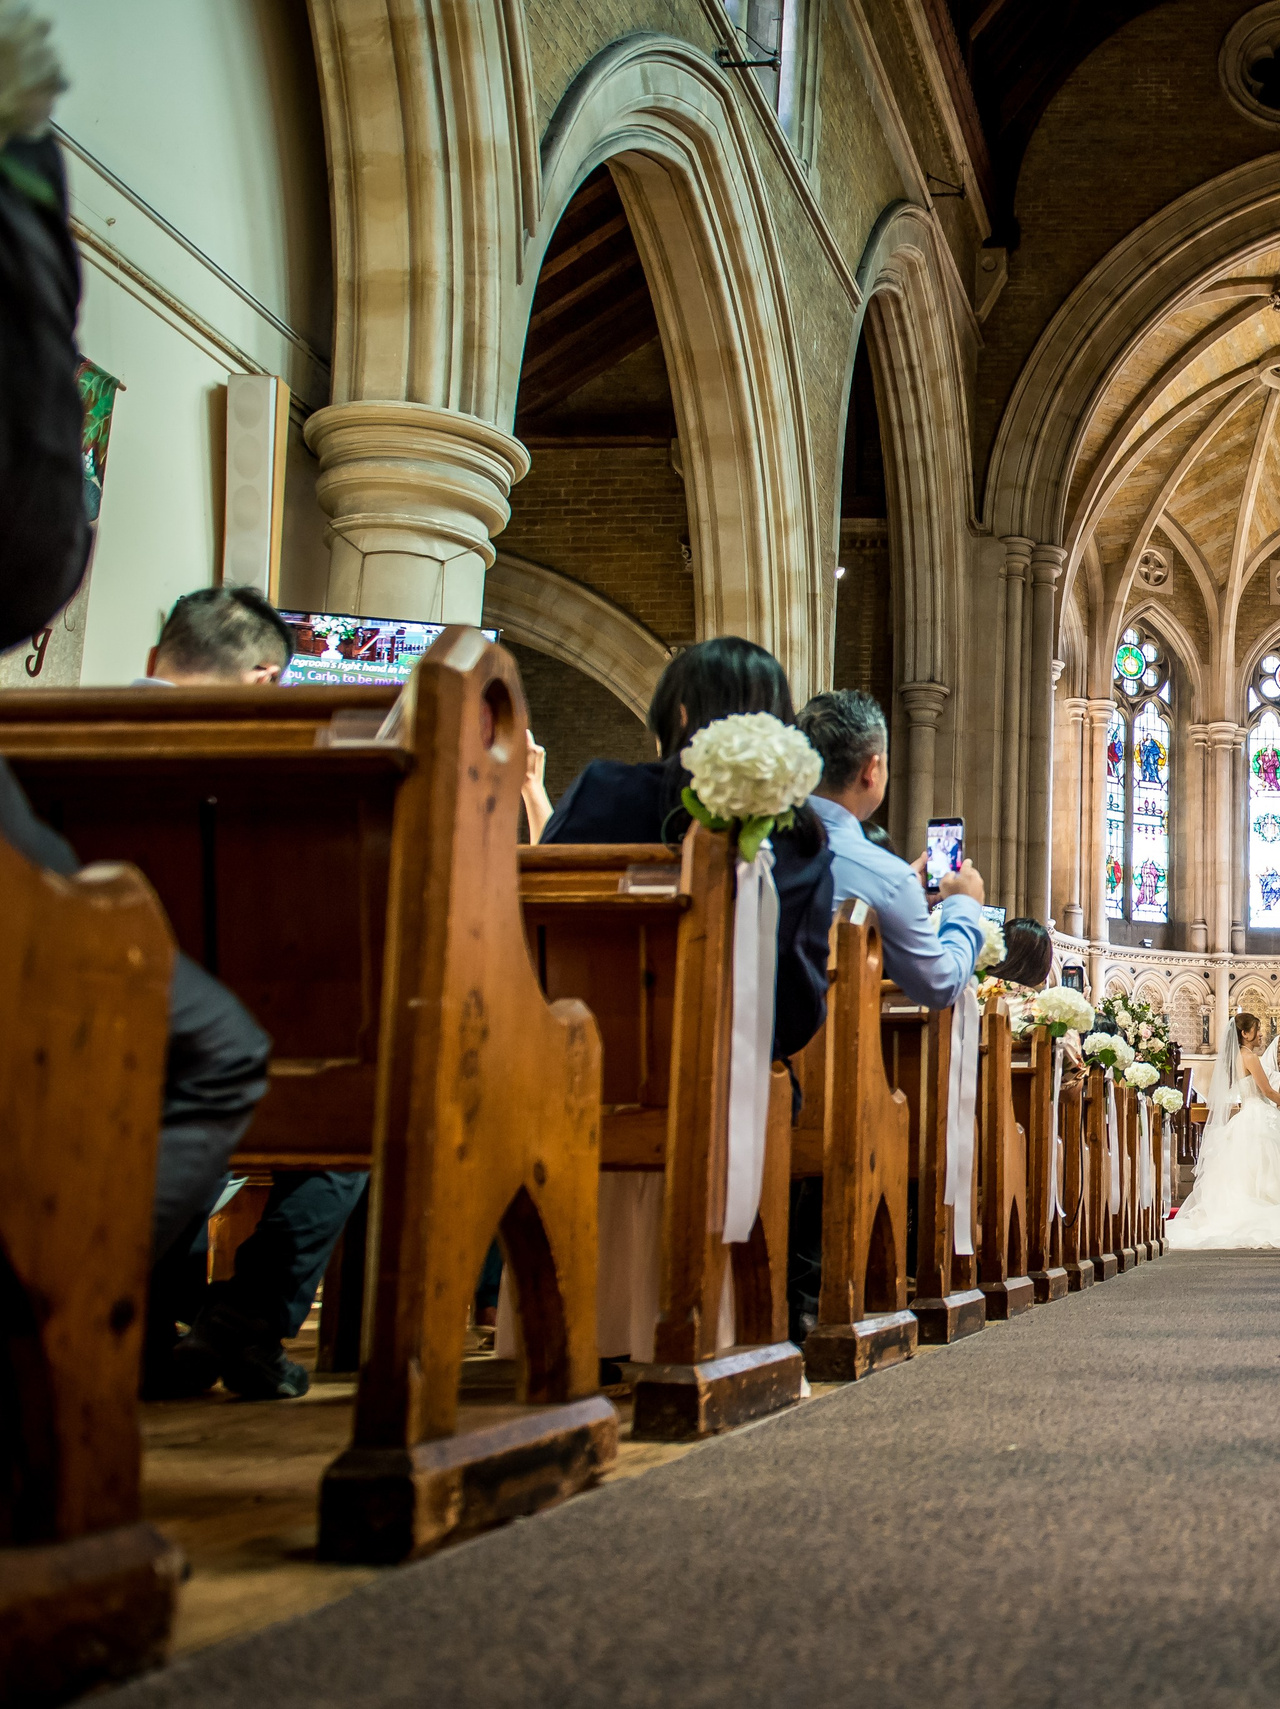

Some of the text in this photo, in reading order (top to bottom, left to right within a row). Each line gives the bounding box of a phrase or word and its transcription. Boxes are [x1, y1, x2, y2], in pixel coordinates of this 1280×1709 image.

[337, 661, 361, 672] right
[362, 662, 388, 673] hand
[388, 665, 398, 675] in
[287, 670, 306, 681] ou,
[307, 670, 341, 684] Carlo,
[342, 673, 356, 683] to
[357, 674, 373, 685] be
